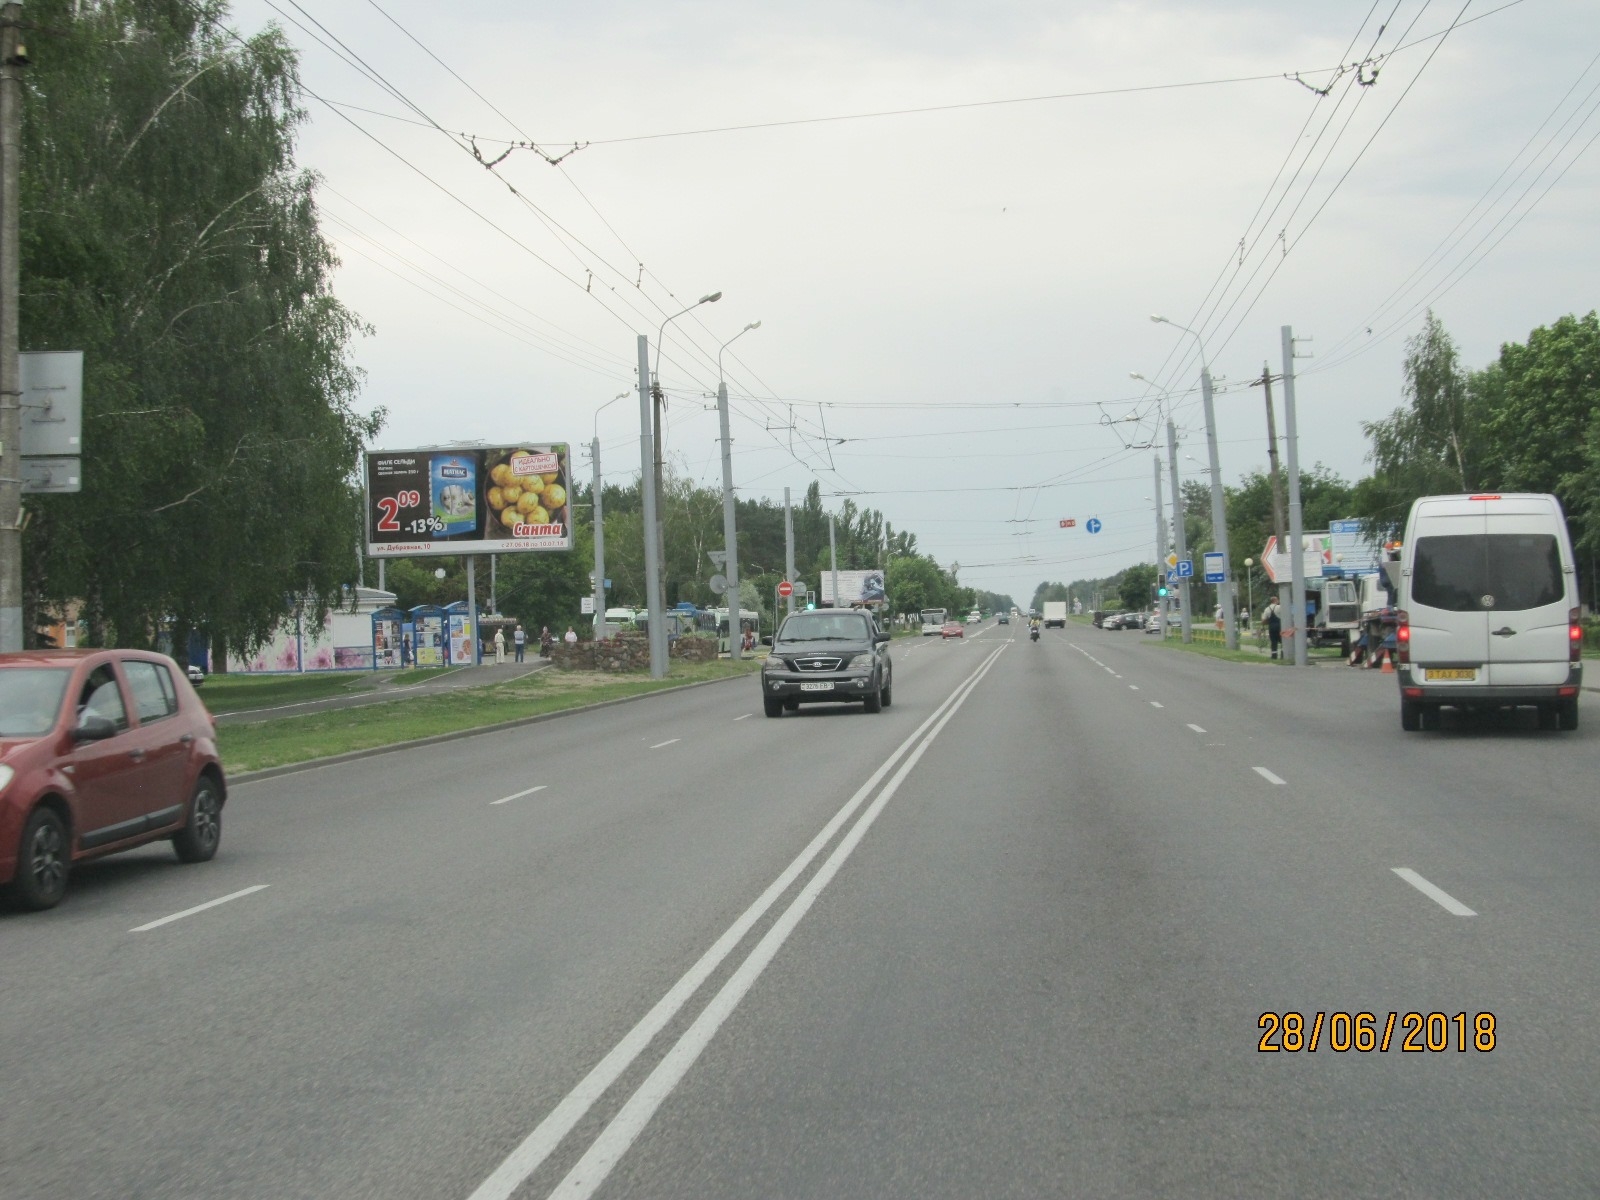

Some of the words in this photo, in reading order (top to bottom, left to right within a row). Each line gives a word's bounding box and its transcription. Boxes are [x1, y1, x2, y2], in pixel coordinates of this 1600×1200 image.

[518, 456, 551, 465] ИДЕАЛЬНО
[377, 497, 400, 532] 2
[398, 490, 420, 508] 09
[405, 516, 443, 534] -13%
[513, 521, 562, 537] Санта
[1179, 562, 1189, 576] P
